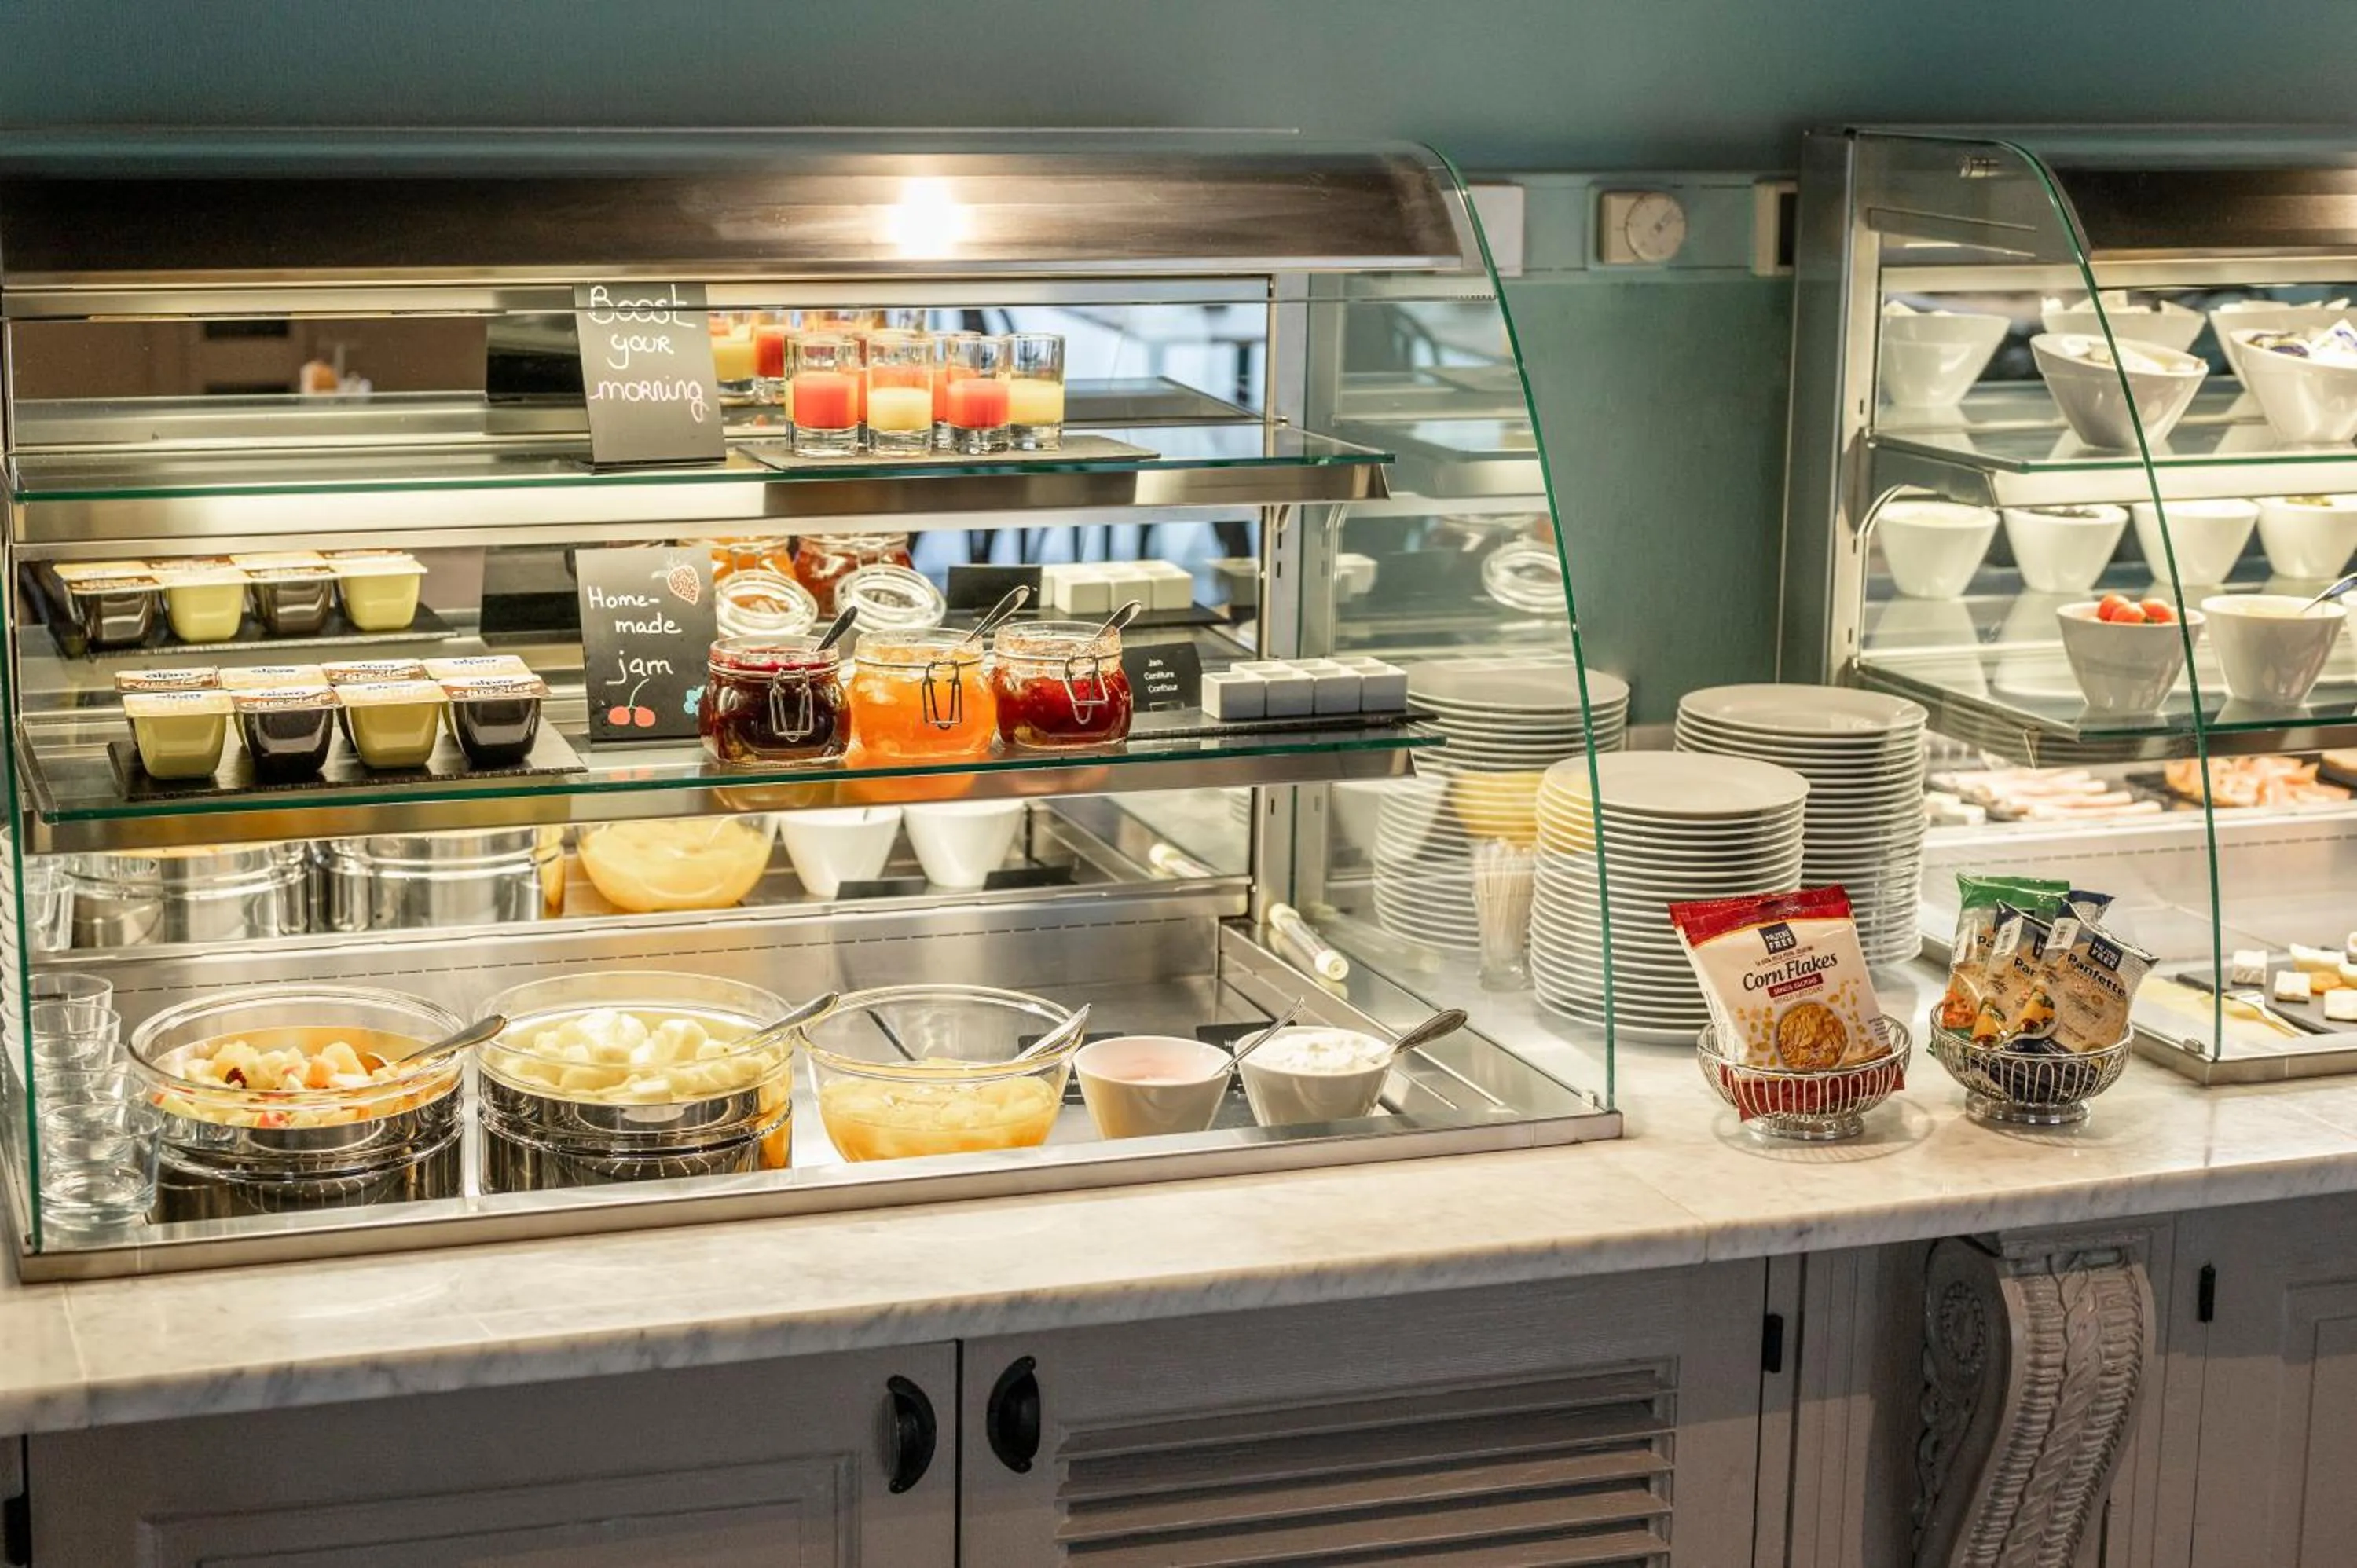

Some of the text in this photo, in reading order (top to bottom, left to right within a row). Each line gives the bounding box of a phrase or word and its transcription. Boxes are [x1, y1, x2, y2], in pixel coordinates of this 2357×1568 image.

[588, 284, 697, 328] Boost
[587, 584, 661, 610] Home-
[615, 611, 684, 634] made
[605, 650, 674, 685] jam
[1768, 935, 1794, 951] FREE
[1743, 969, 1785, 992] Corn
[1785, 953, 1838, 980] Flakes
[2066, 952, 2126, 998] Panfette
